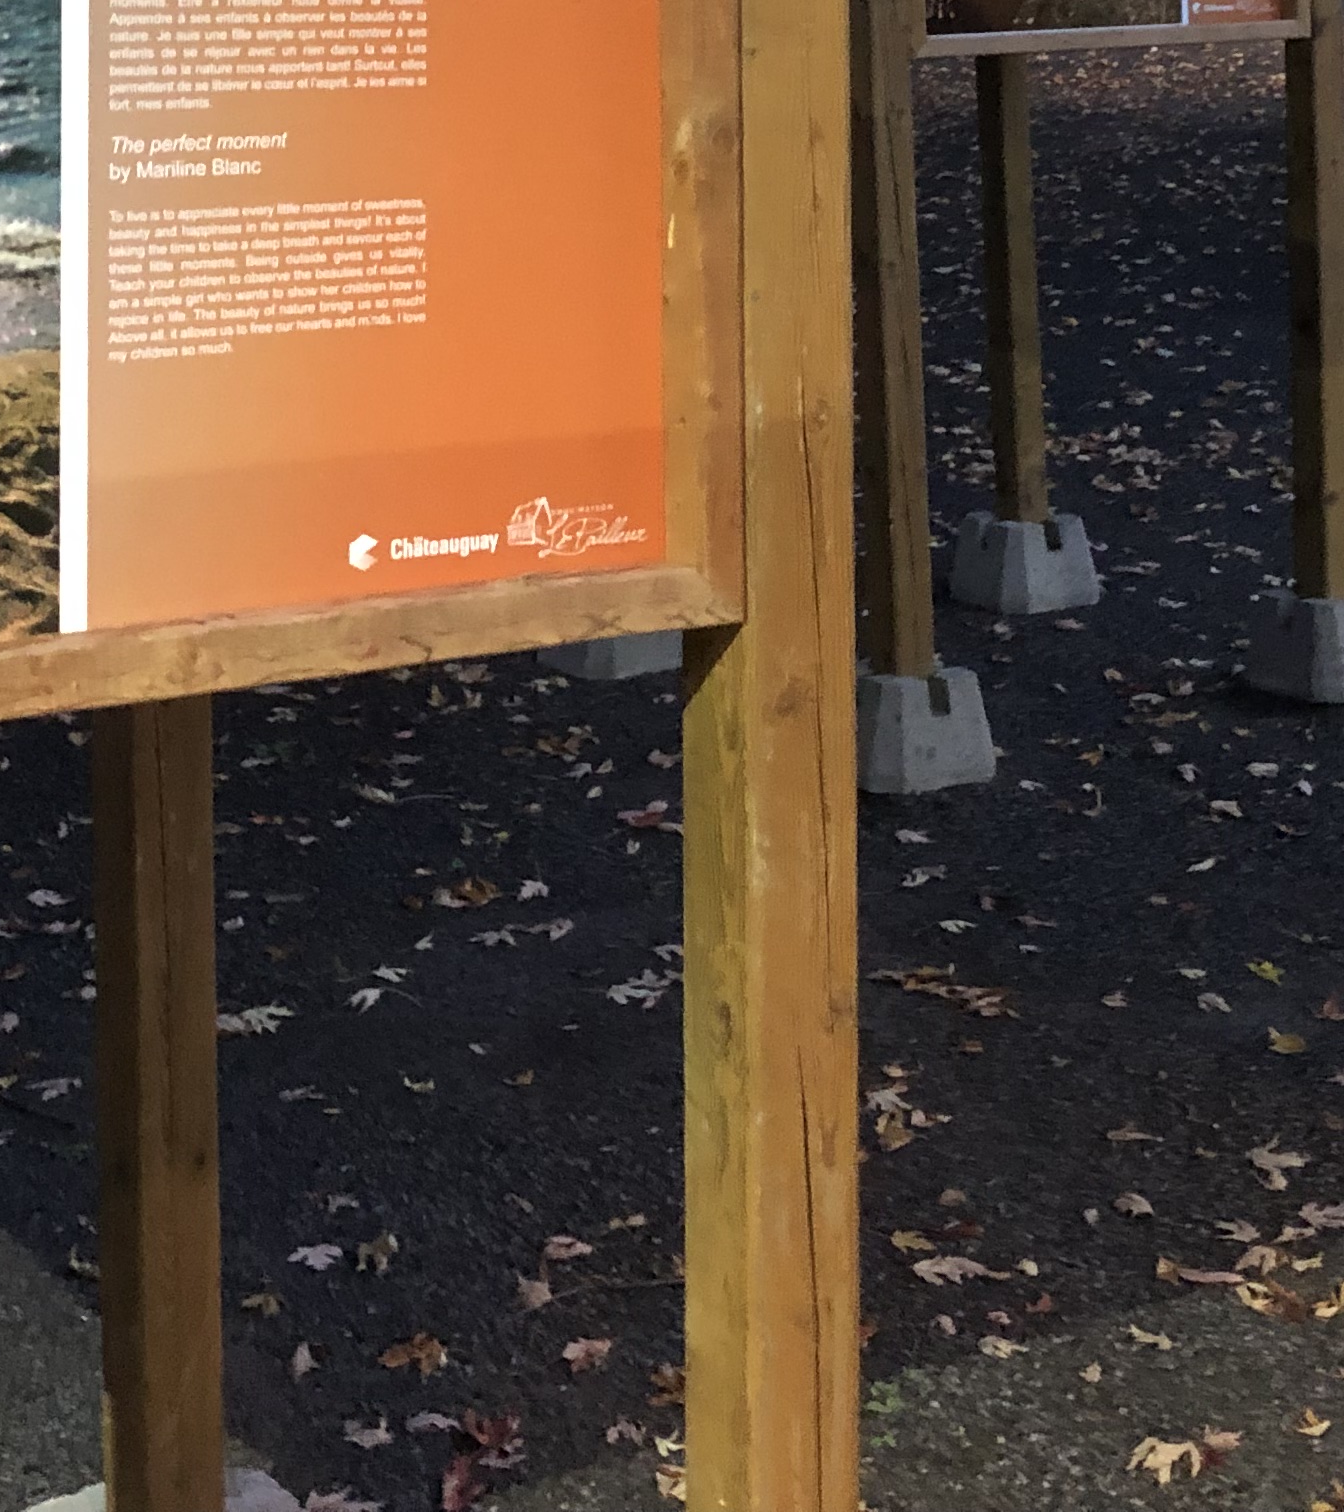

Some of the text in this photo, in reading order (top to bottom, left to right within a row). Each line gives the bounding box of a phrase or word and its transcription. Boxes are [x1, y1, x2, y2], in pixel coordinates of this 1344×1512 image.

[156, 31, 172, 41] Je
[112, 131, 288, 157] The perfect moment
[109, 157, 261, 184] by Mariline Blanc
[350, 200, 362, 212] of
[414, 228, 426, 241] of
[390, 533, 500, 560] Châteauguay
